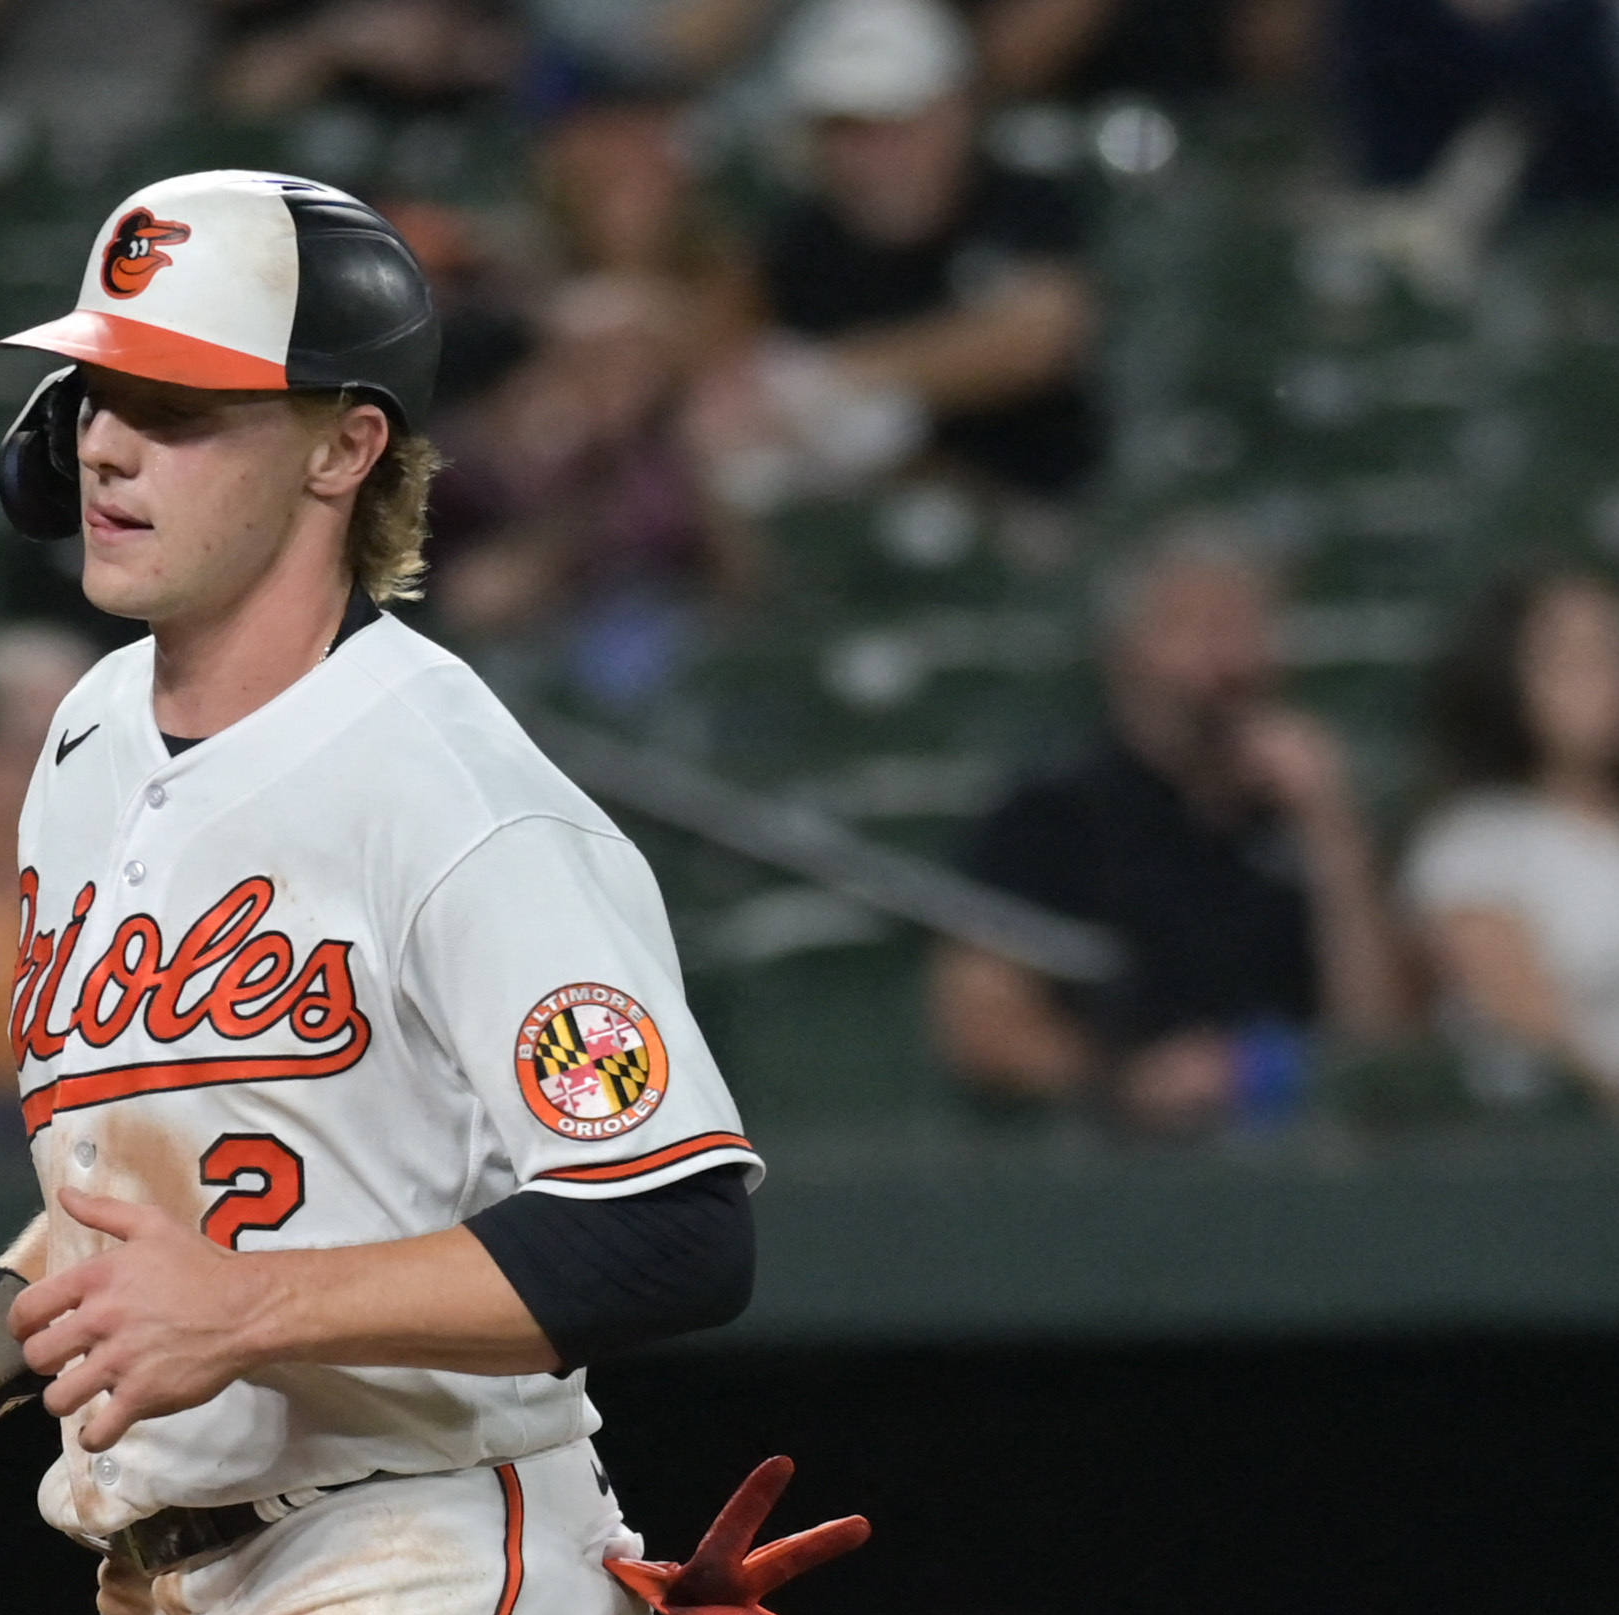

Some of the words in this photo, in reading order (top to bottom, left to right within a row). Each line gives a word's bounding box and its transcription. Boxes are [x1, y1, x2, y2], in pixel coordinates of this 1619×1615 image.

[518, 987, 645, 1060] BALTIMORE
[557, 1087, 660, 1136] ORIOLES
[199, 1133, 305, 1252] 2
